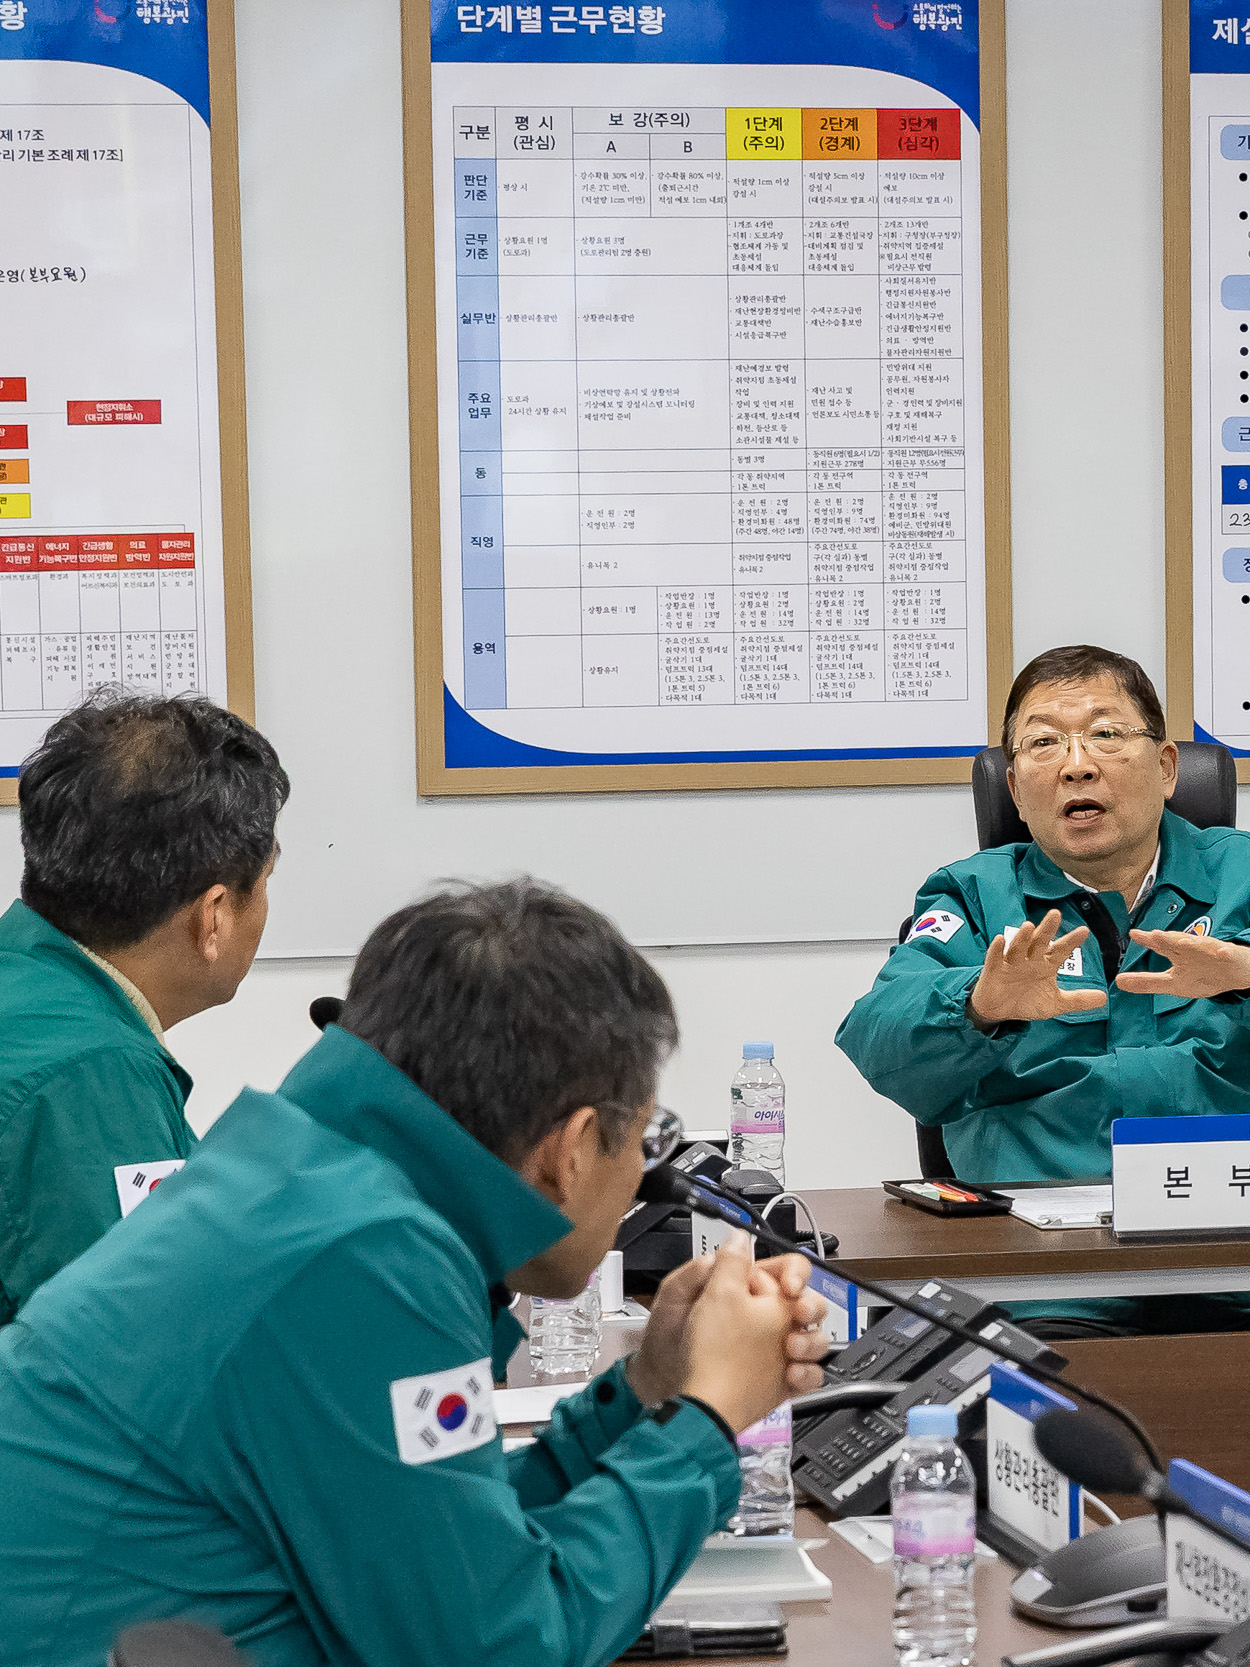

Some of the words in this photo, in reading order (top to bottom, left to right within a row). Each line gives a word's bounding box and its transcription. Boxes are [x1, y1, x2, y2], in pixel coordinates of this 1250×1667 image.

[458, 5, 541, 33] 단계별
[549, 6, 666, 34] 근무현황
[913, 12, 962, 31] 행복광진
[745, 117, 782, 131] 1단계
[820, 117, 858, 131] 2단계
[900, 117, 937, 132] 3단계
[18, 130, 44, 140] 17조
[459, 125, 490, 140] 구분
[514, 135, 555, 150] (관심)
[607, 141, 616, 152] A
[684, 141, 692, 152] B
[744, 136, 784, 151] (주의)
[819, 136, 860, 151] (경계)
[898, 136, 939, 151] (심각)
[18, 149, 44, 162] 기본
[47, 149, 73, 161] 조례
[464, 175, 487, 186] 판단
[464, 190, 487, 201] 기준
[465, 234, 488, 245] 근무
[466, 249, 488, 259] 기준
[460, 313, 496, 324] 실무반
[468, 393, 491, 404] 주요
[468, 408, 491, 418] 업무
[475, 468, 486, 479] 동
[471, 537, 493, 548] 직영
[473, 643, 495, 654] 용역
